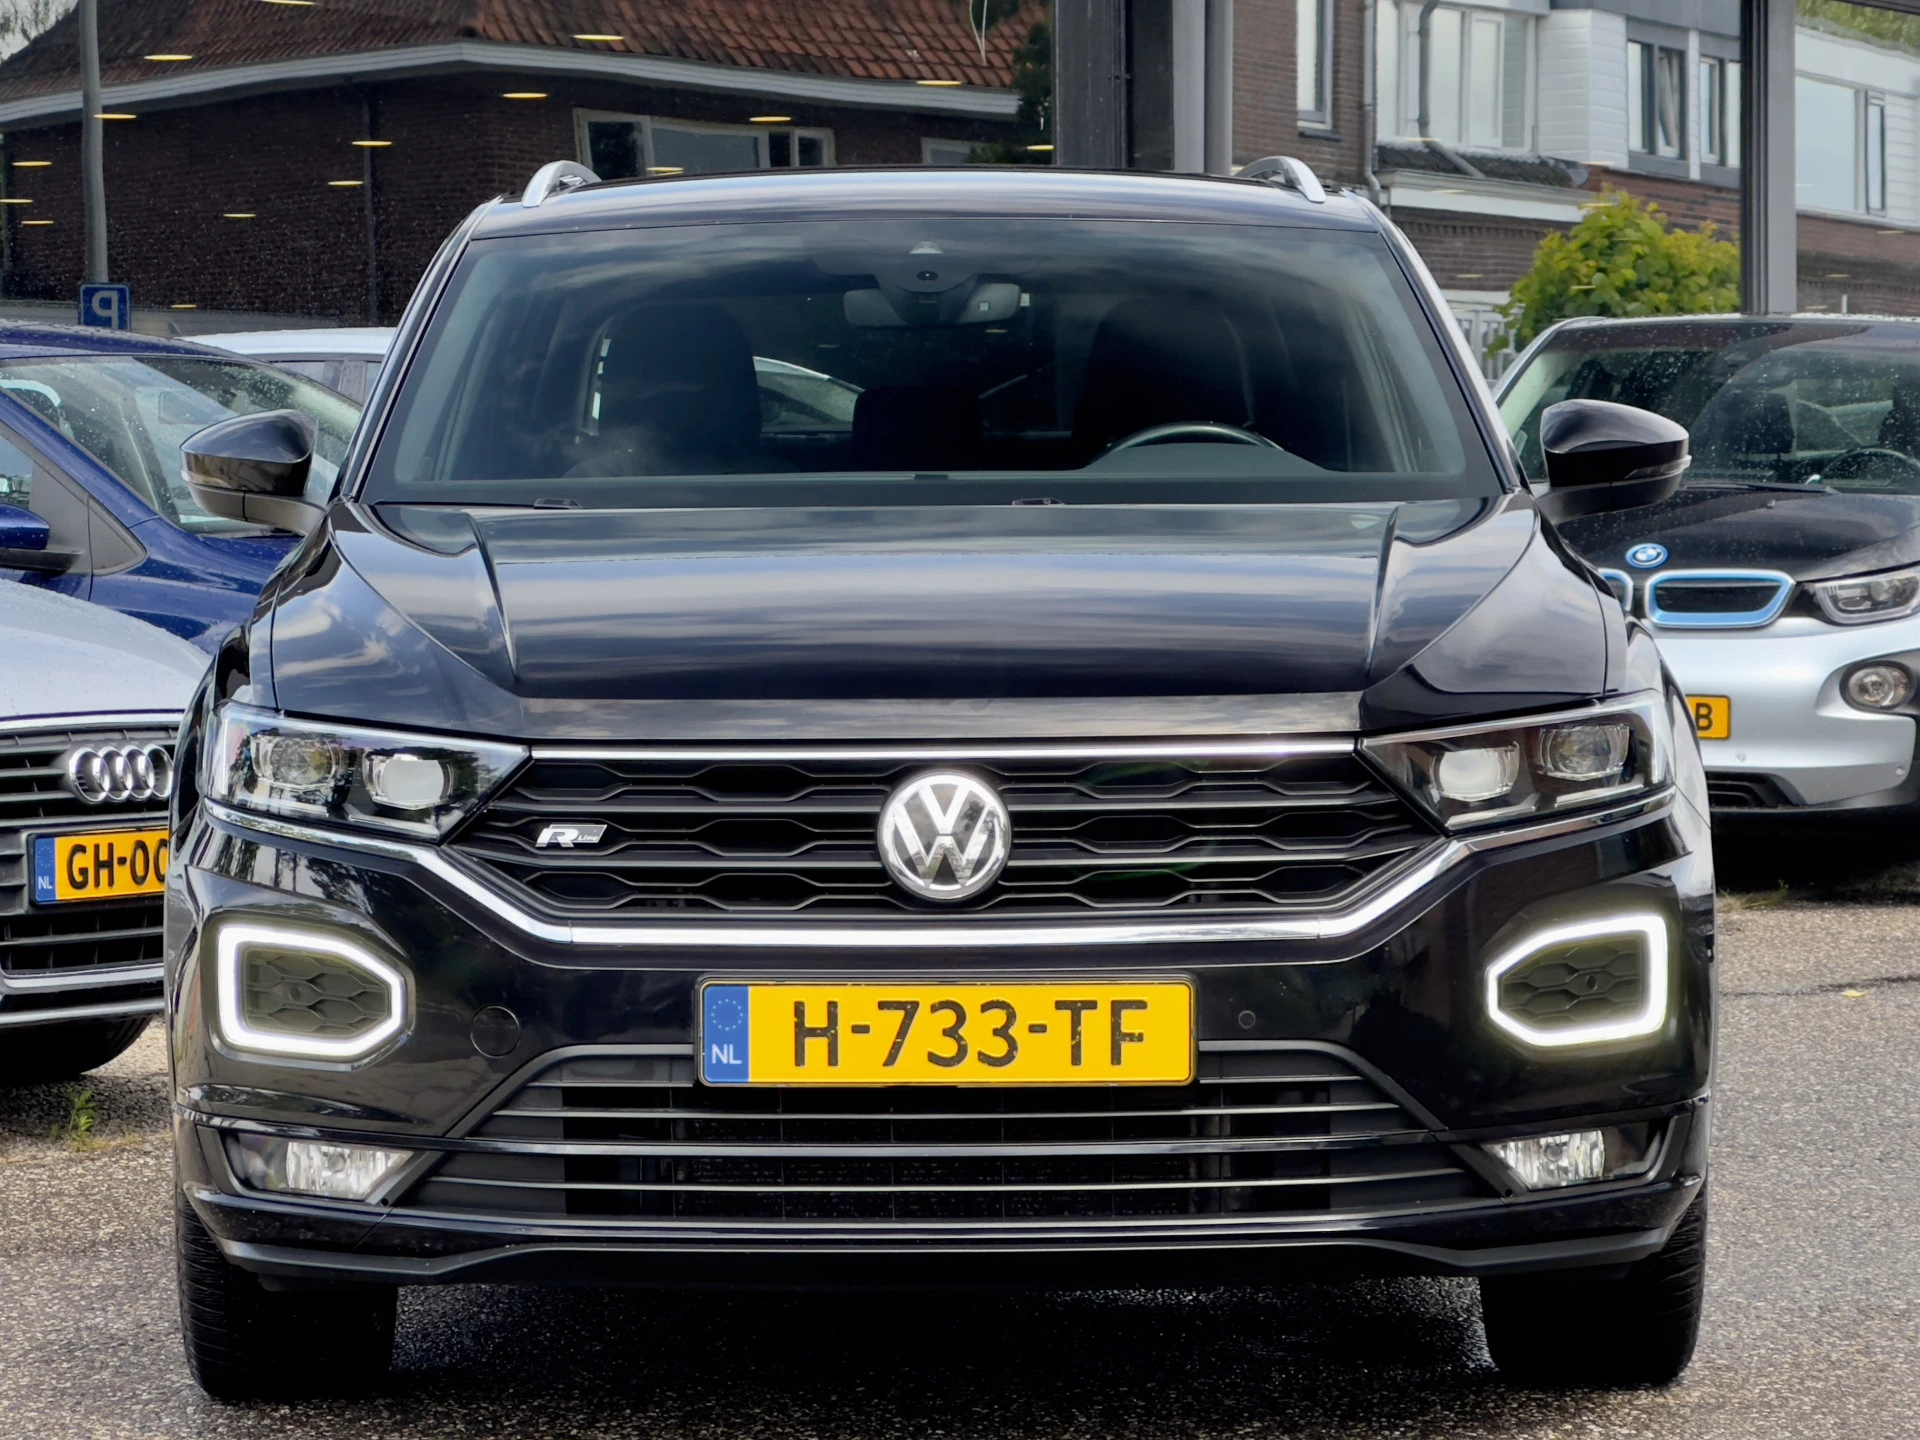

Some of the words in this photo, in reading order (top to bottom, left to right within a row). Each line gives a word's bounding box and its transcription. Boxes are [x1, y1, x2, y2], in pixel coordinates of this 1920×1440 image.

[38, 876, 52, 889] NL
[793, 999, 1148, 1067] H-733-TF
[711, 1043, 742, 1064] NL
